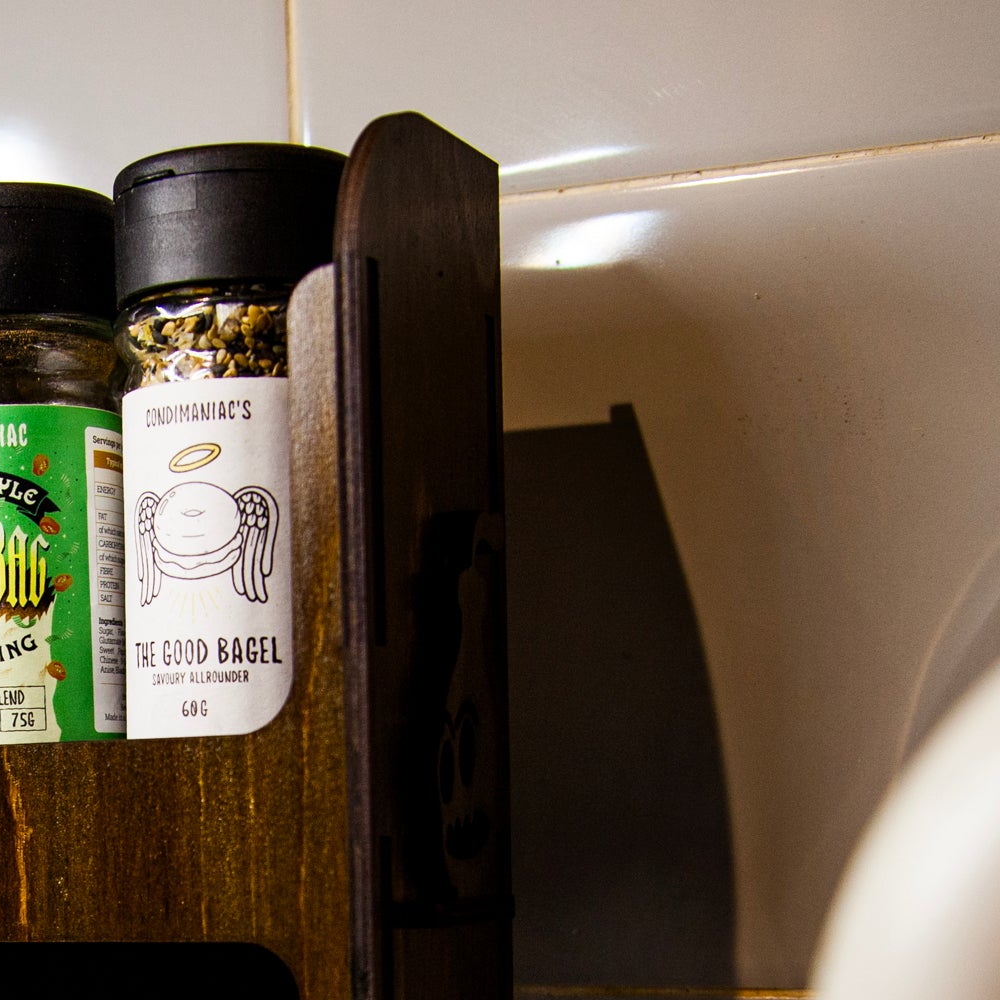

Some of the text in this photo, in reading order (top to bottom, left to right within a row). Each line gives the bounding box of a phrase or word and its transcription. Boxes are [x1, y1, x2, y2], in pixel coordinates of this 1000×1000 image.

[146, 400, 252, 428] CONDIMANIAC'S
[98, 512, 108, 520] FAT
[100, 594, 112, 602] SALT
[135, 636, 283, 668] THE GOOD BAGEL
[152, 670, 249, 686] SAVOURY ALLROUNDER
[181, 700, 209, 718] 60G
[12, 712, 36, 727] 75G
